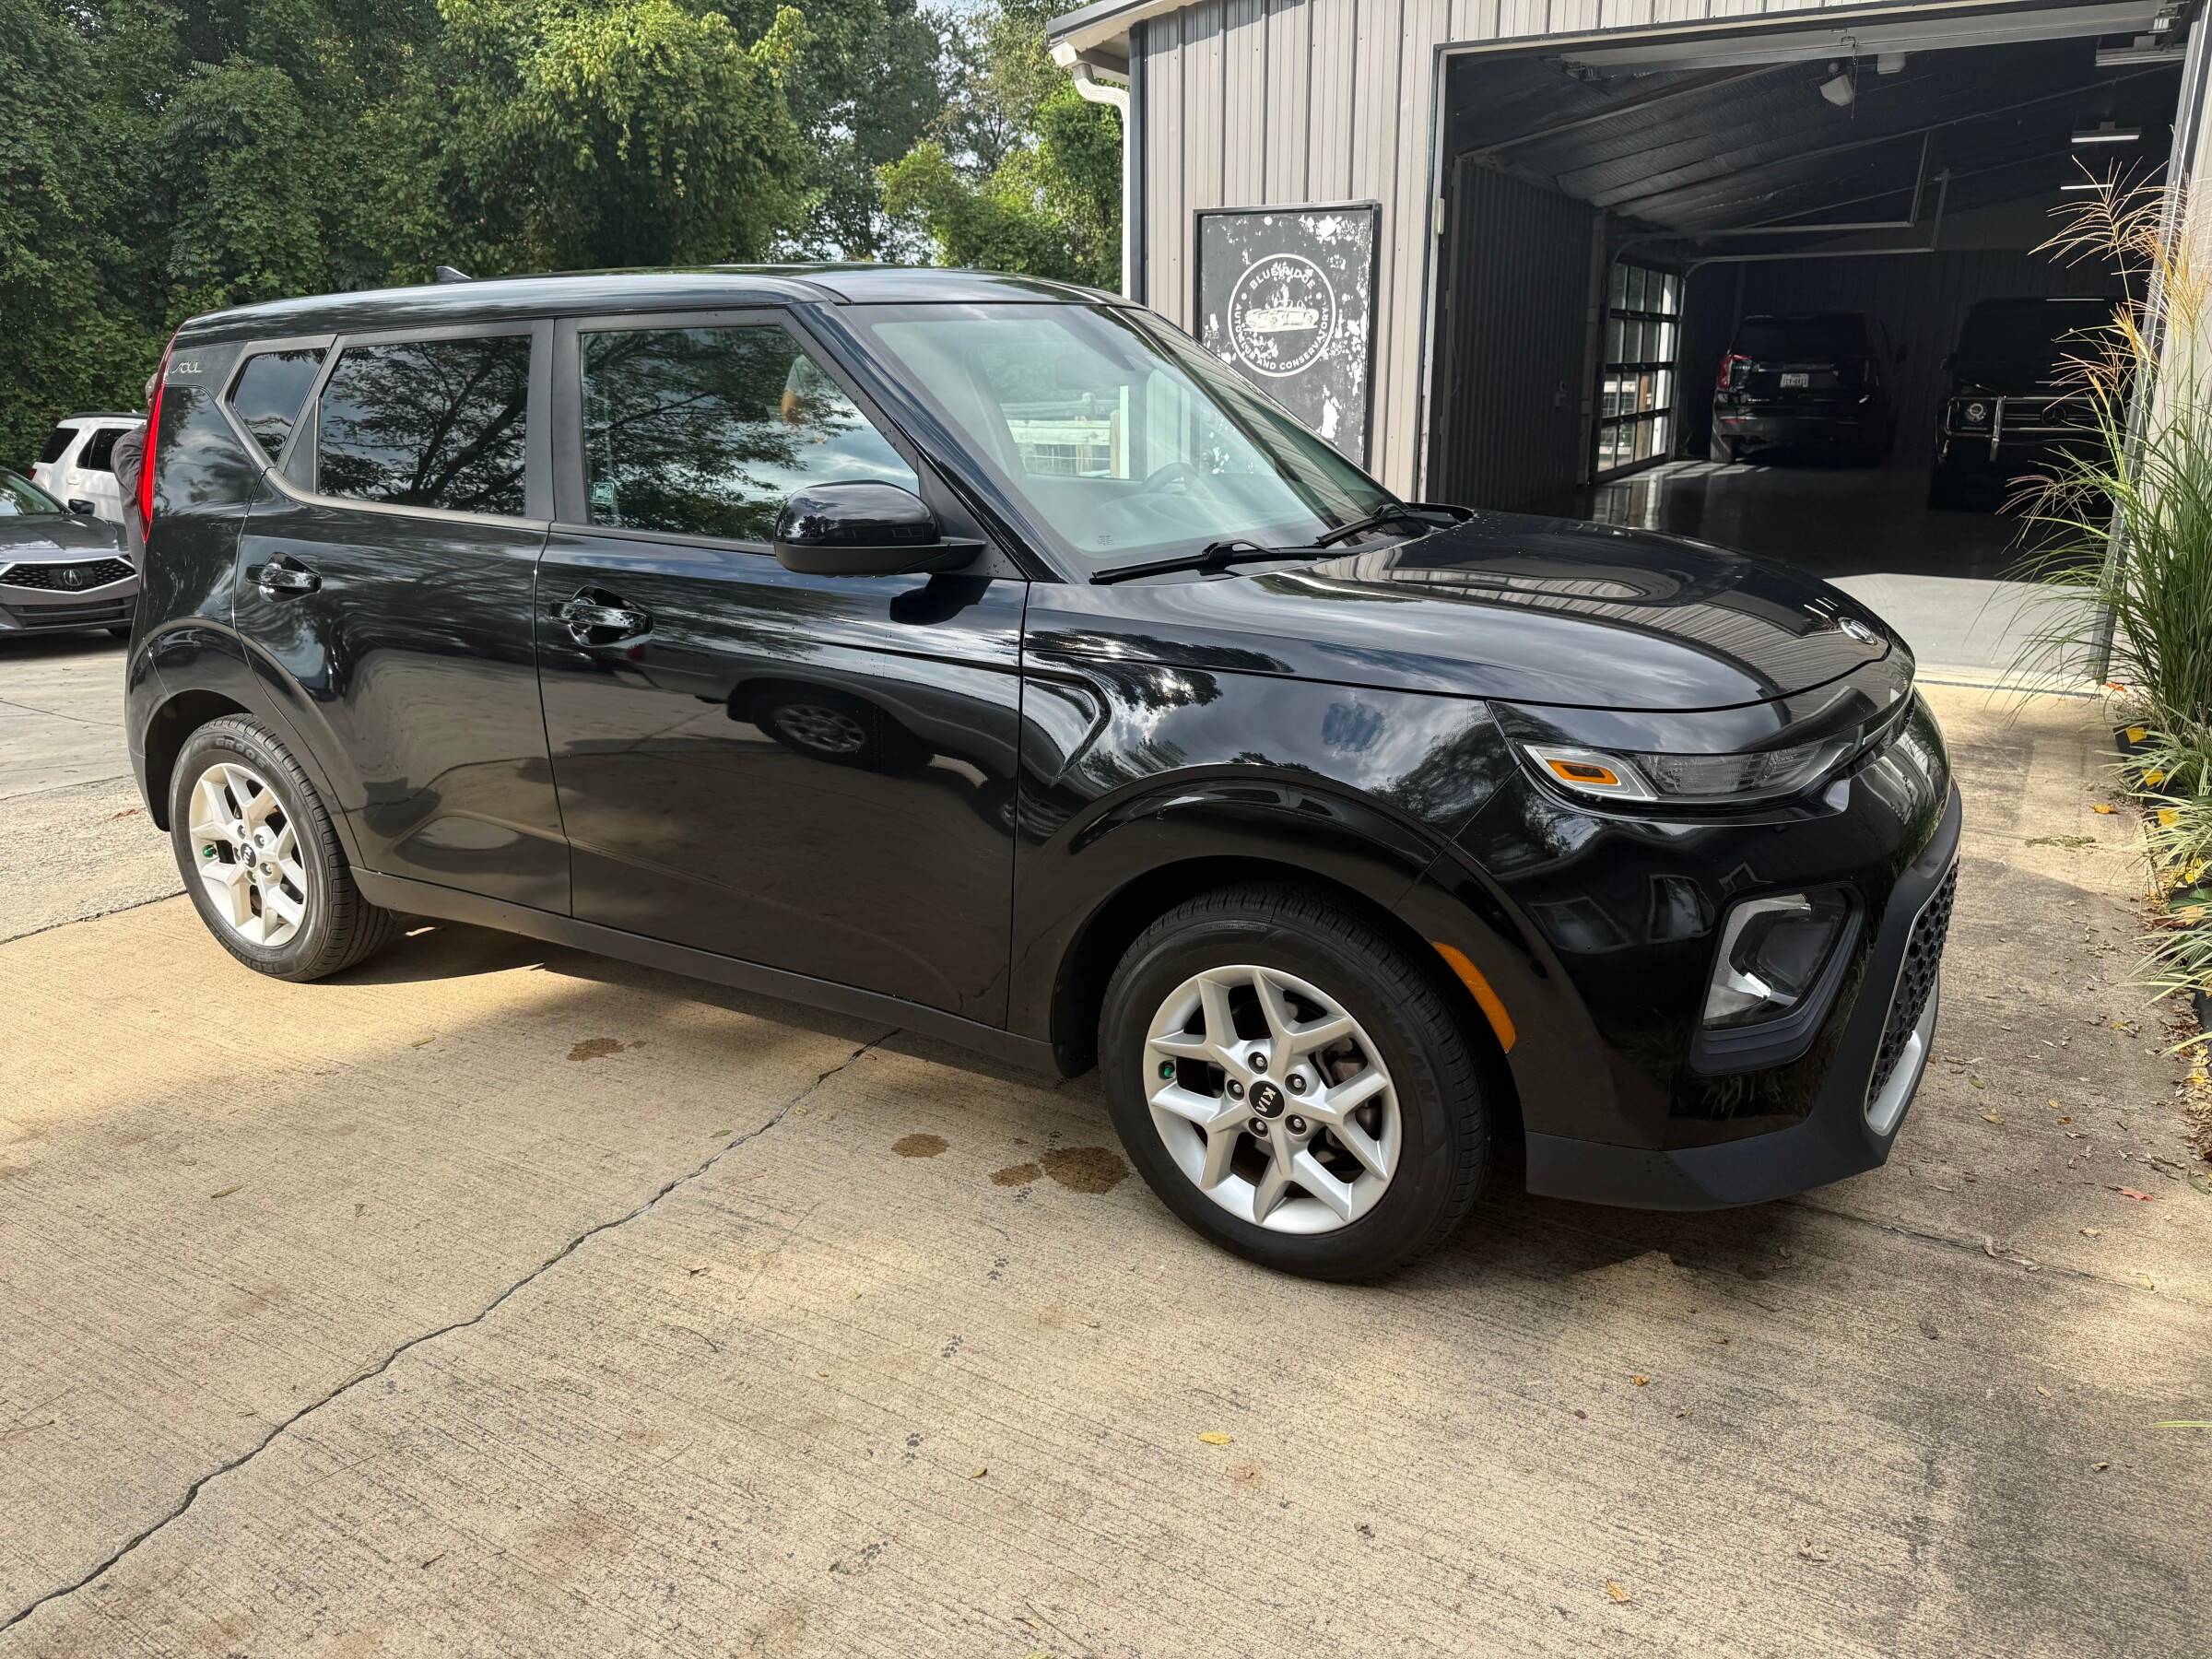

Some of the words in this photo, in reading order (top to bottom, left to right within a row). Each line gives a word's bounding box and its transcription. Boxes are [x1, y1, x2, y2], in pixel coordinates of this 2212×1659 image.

[1249, 267, 1279, 290] BLUE
[1234, 303, 1242, 332] AUTO
[1256, 358, 1277, 370] AND
[1279, 307, 1329, 371] CONSERVATORY
[1255, 1086, 1277, 1112] KIA
